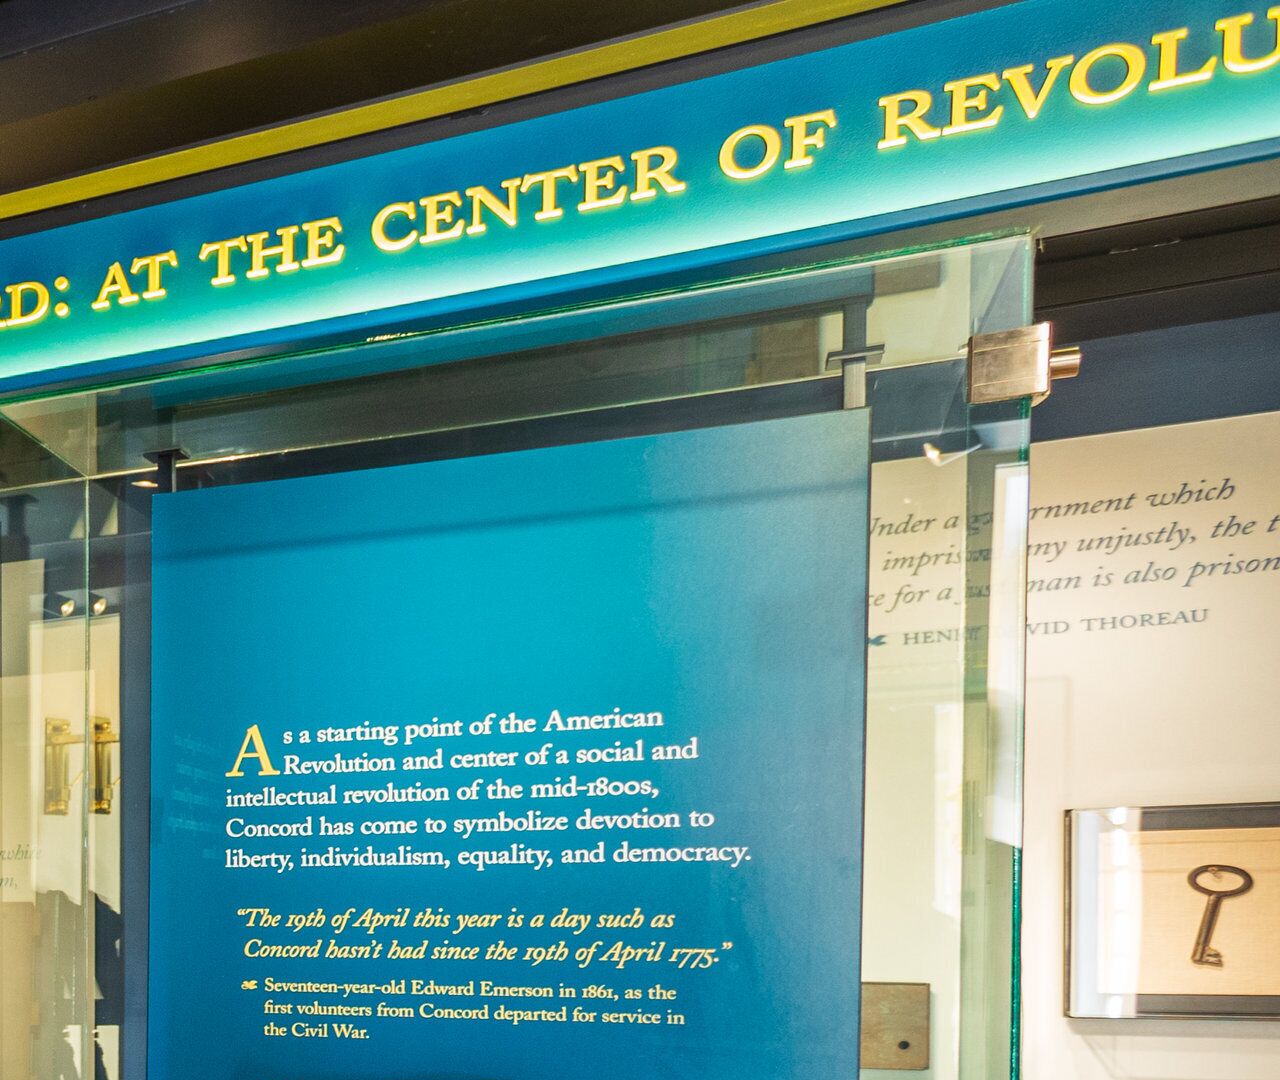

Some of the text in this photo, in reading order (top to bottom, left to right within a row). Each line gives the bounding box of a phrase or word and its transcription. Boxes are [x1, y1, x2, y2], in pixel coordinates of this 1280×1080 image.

[91, 249, 177, 310] AT
[199, 216, 346, 287] THE
[371, 145, 686, 252] CENTER
[718, 108, 839, 180] OF
[877, 5, 1280, 150] REVOLU
[1146, 476, 1236, 509] which
[943, 515, 961, 530] a
[1078, 522, 1196, 556] unjustly,
[1210, 515, 1255, 540] the
[1093, 566, 1114, 587] is
[1124, 561, 1177, 585] also
[885, 584, 929, 613] for
[936, 588, 952, 600] a
[1080, 608, 1210, 632] THOREAU
[299, 730, 310, 743] a
[317, 721, 398, 744] starting
[404, 717, 462, 742] point
[468, 712, 496, 734] of
[499, 712, 535, 733] the
[542, 707, 663, 731] American
[283, 736, 698, 775] Revolution and center of a social and
[225, 775, 659, 807] intellectual revolution of the mid-1800s,
[225, 807, 715, 838] Concord has come to symbolize devotion to
[225, 840, 751, 873] liberty, individualism, equality, and democracy.
[237, 907, 675, 934] “The 19th of April this year is a day such as
[243, 938, 732, 968] Concord hasn’t had since the 19th of April 1775.”
[264, 977, 676, 1001] Seventeen-year-old Edward Emerson in 1861, as the
[264, 999, 684, 1024] first volunteers from Concord departed for service in
[263, 1021, 369, 1038] the Civil War.
